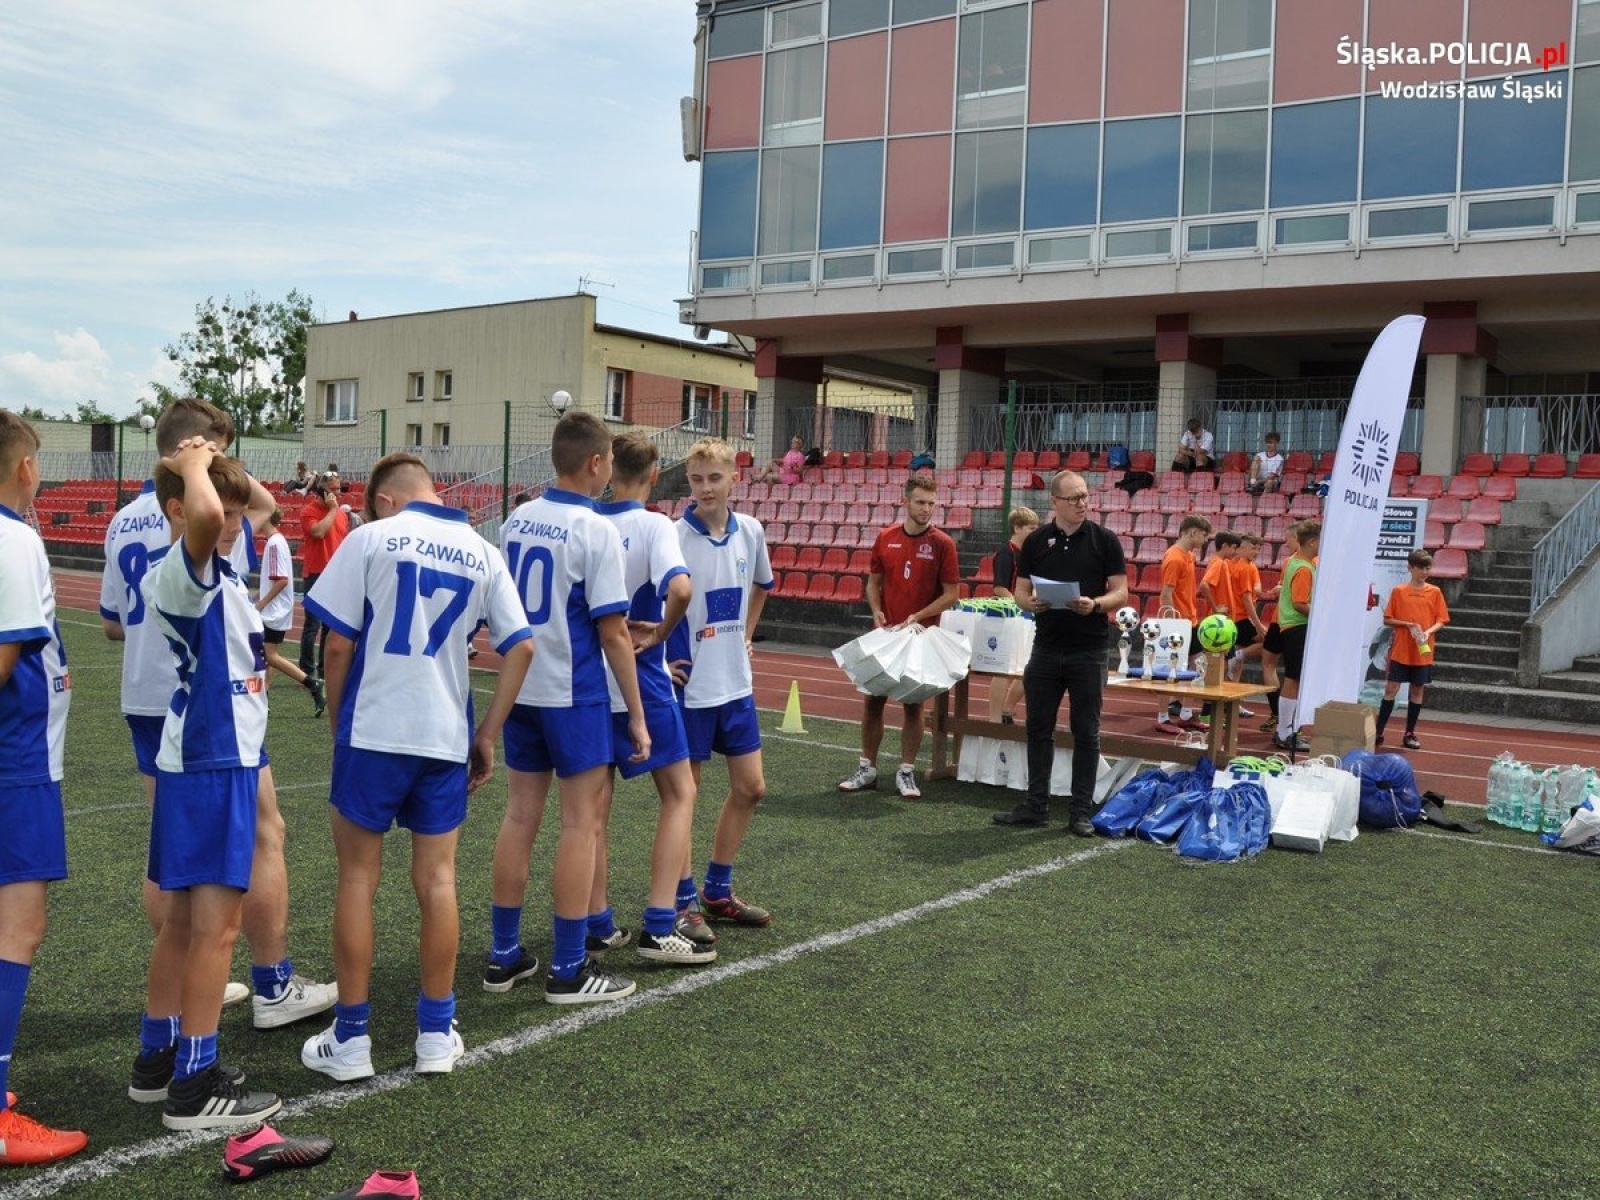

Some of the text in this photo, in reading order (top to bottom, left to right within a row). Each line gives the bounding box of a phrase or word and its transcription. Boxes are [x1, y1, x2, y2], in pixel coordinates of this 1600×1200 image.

[1343, 488, 1379, 512] POLICJA
[519, 519, 568, 544] ZAWADA
[386, 536, 486, 576] SP ZAWADA
[903, 560, 912, 580] 6
[383, 561, 475, 659] 17
